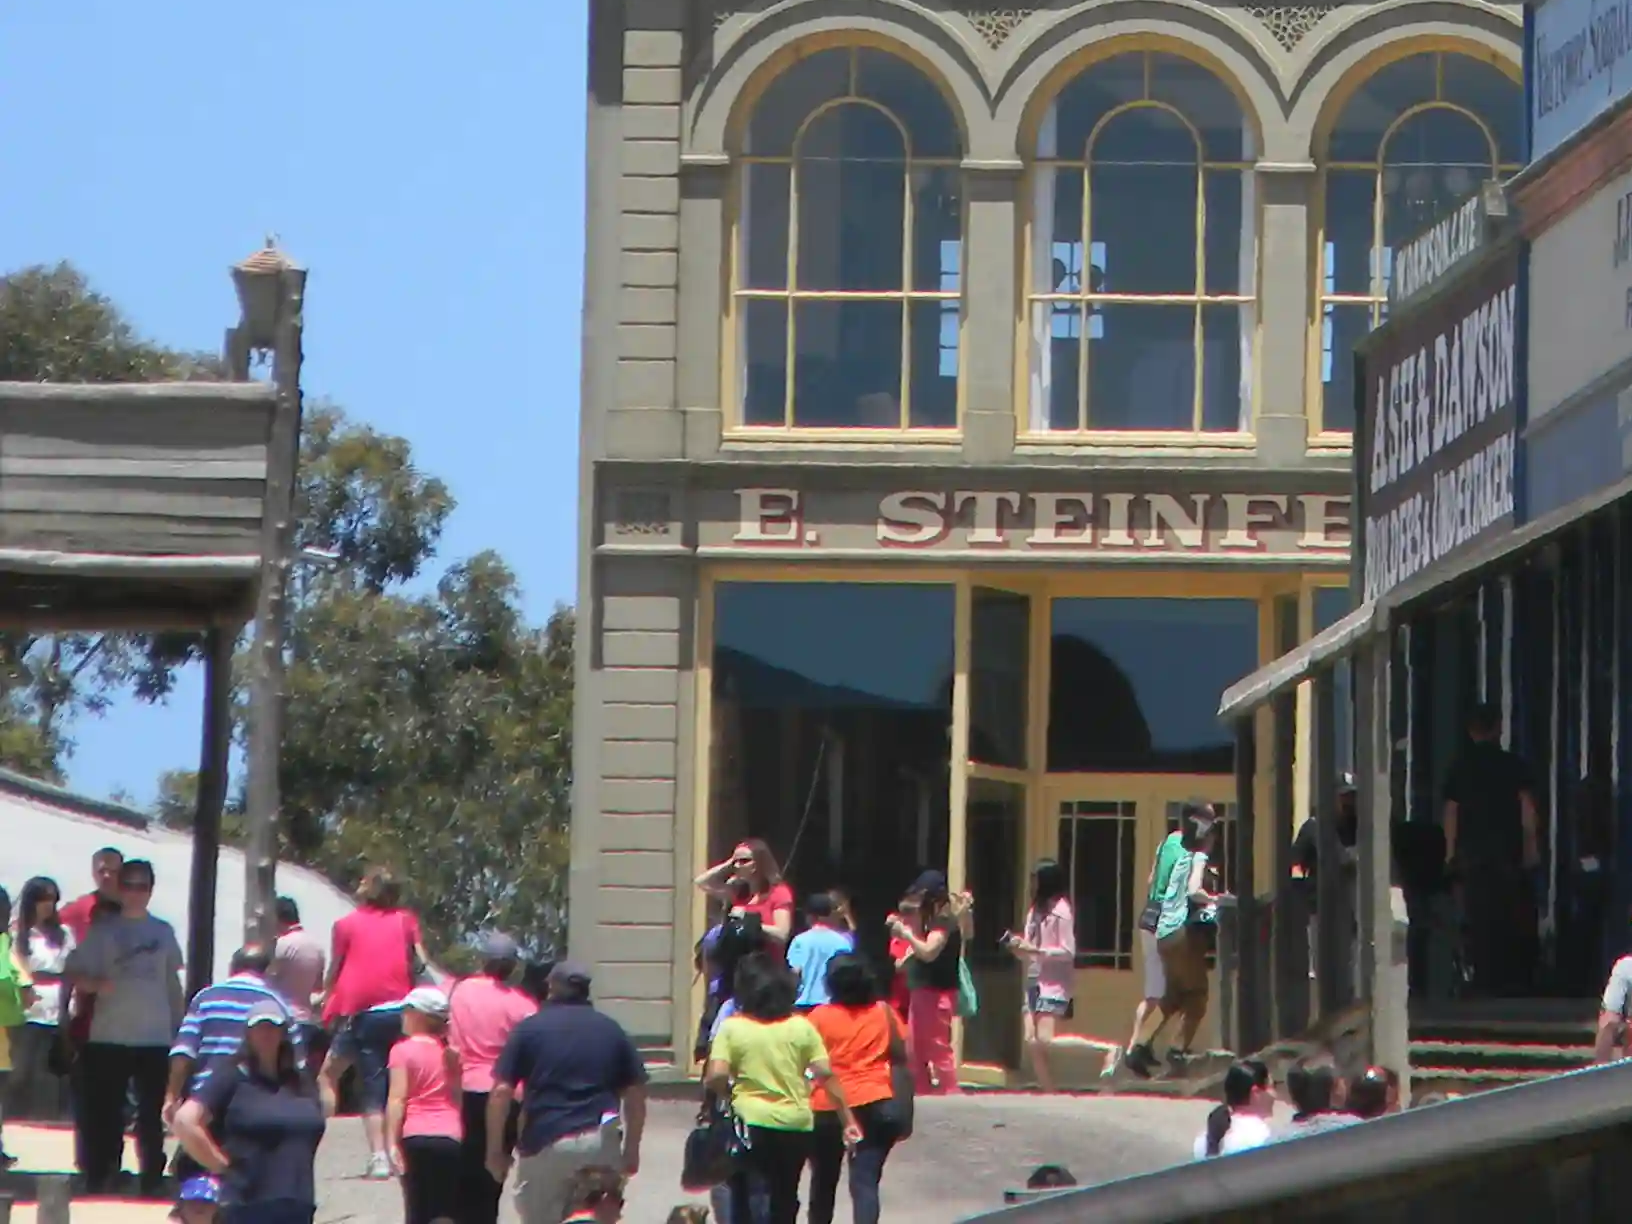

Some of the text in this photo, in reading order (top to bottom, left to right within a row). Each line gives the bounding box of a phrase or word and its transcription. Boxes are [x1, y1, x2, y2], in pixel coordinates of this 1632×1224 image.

[1371, 354, 1416, 493] ASH
[1416, 346, 1430, 465] &
[1433, 284, 1517, 453] DAWSON
[732, 487, 1352, 548] E. STEINFE
